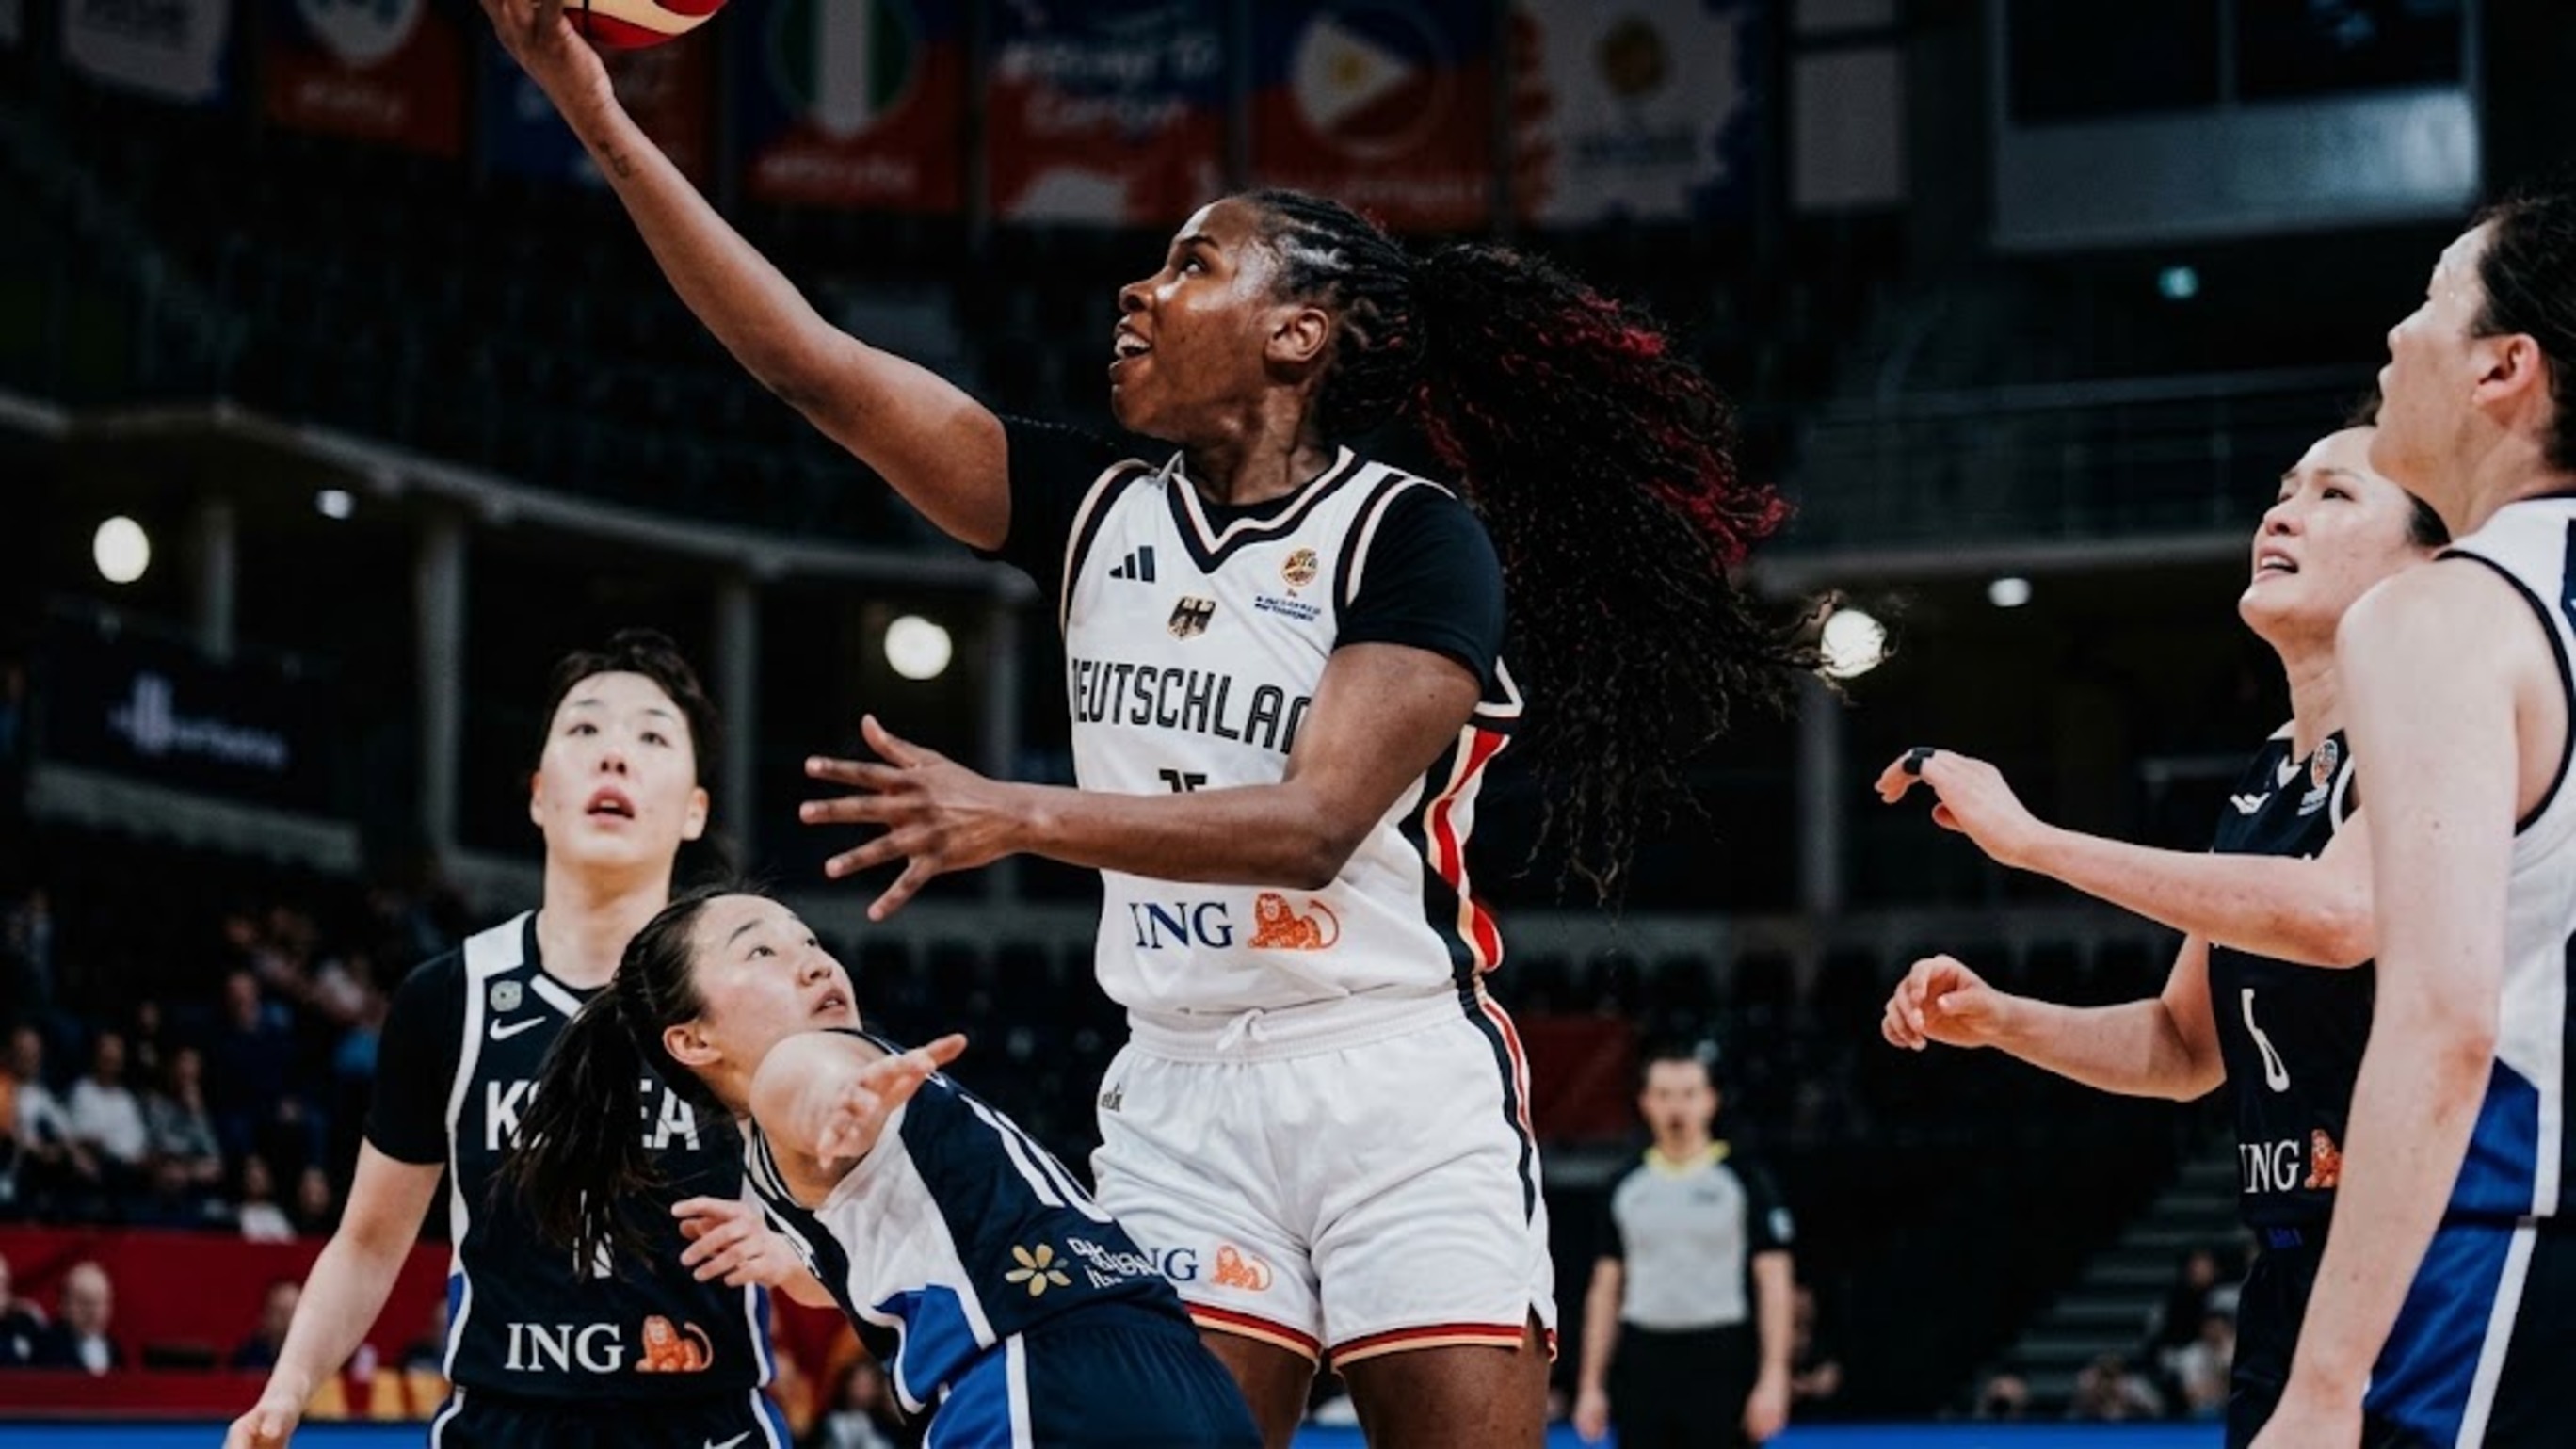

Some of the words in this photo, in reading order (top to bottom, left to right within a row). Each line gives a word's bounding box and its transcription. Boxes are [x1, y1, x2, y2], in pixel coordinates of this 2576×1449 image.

[1128, 901, 1234, 949] ING
[2238, 1139, 2300, 1194] ING
[503, 1322, 625, 1374] ING
